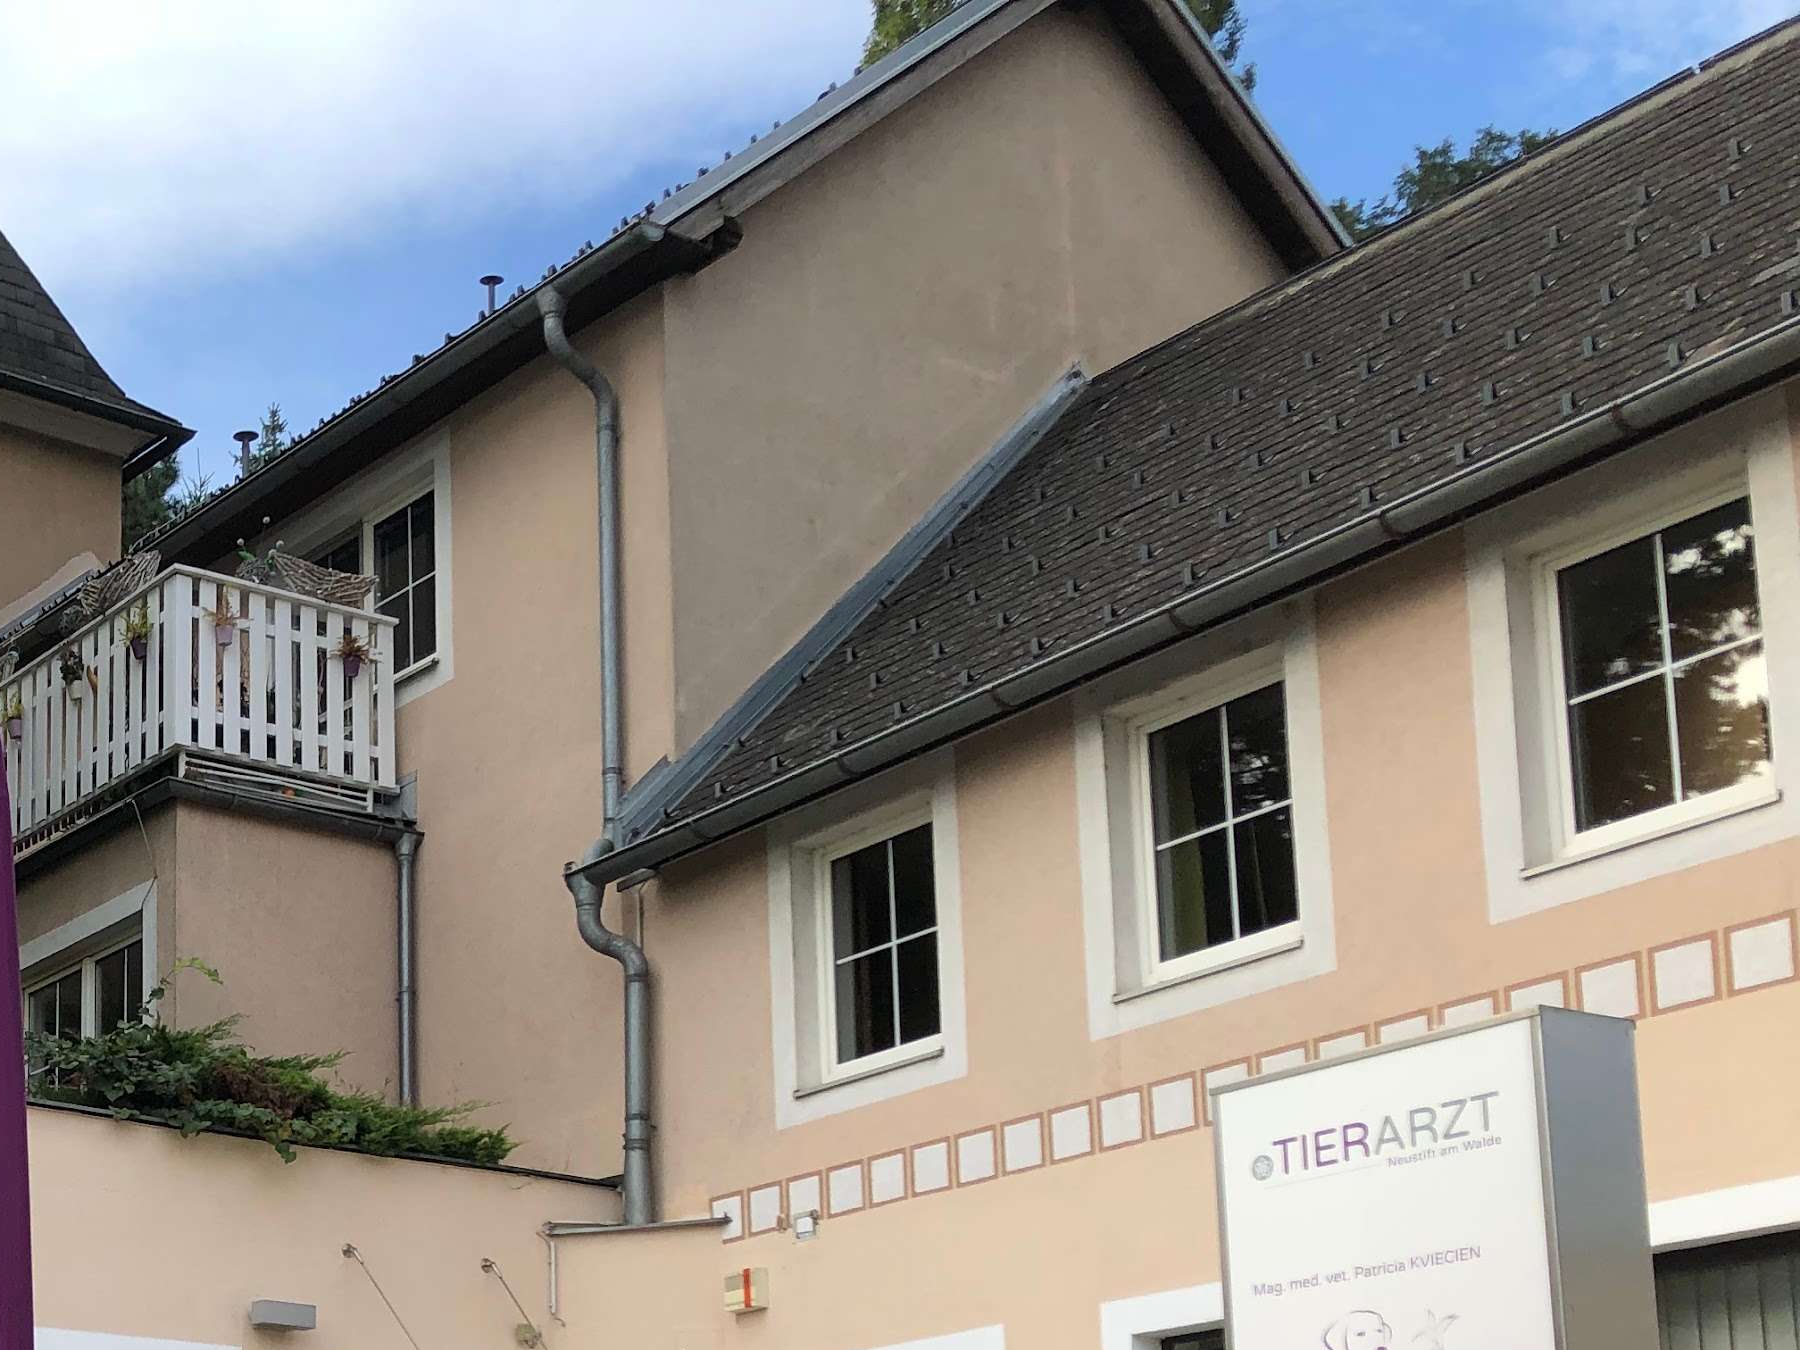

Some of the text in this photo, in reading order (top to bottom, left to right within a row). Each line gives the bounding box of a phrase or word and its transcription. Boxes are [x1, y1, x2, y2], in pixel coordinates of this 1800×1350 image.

[1272, 1091, 1499, 1174] TIERARZT
[1388, 1136, 1502, 1167] Neustift am Walde
[1253, 1246, 1481, 1296] Mag. med. vet. Patricia KVIECIEN
